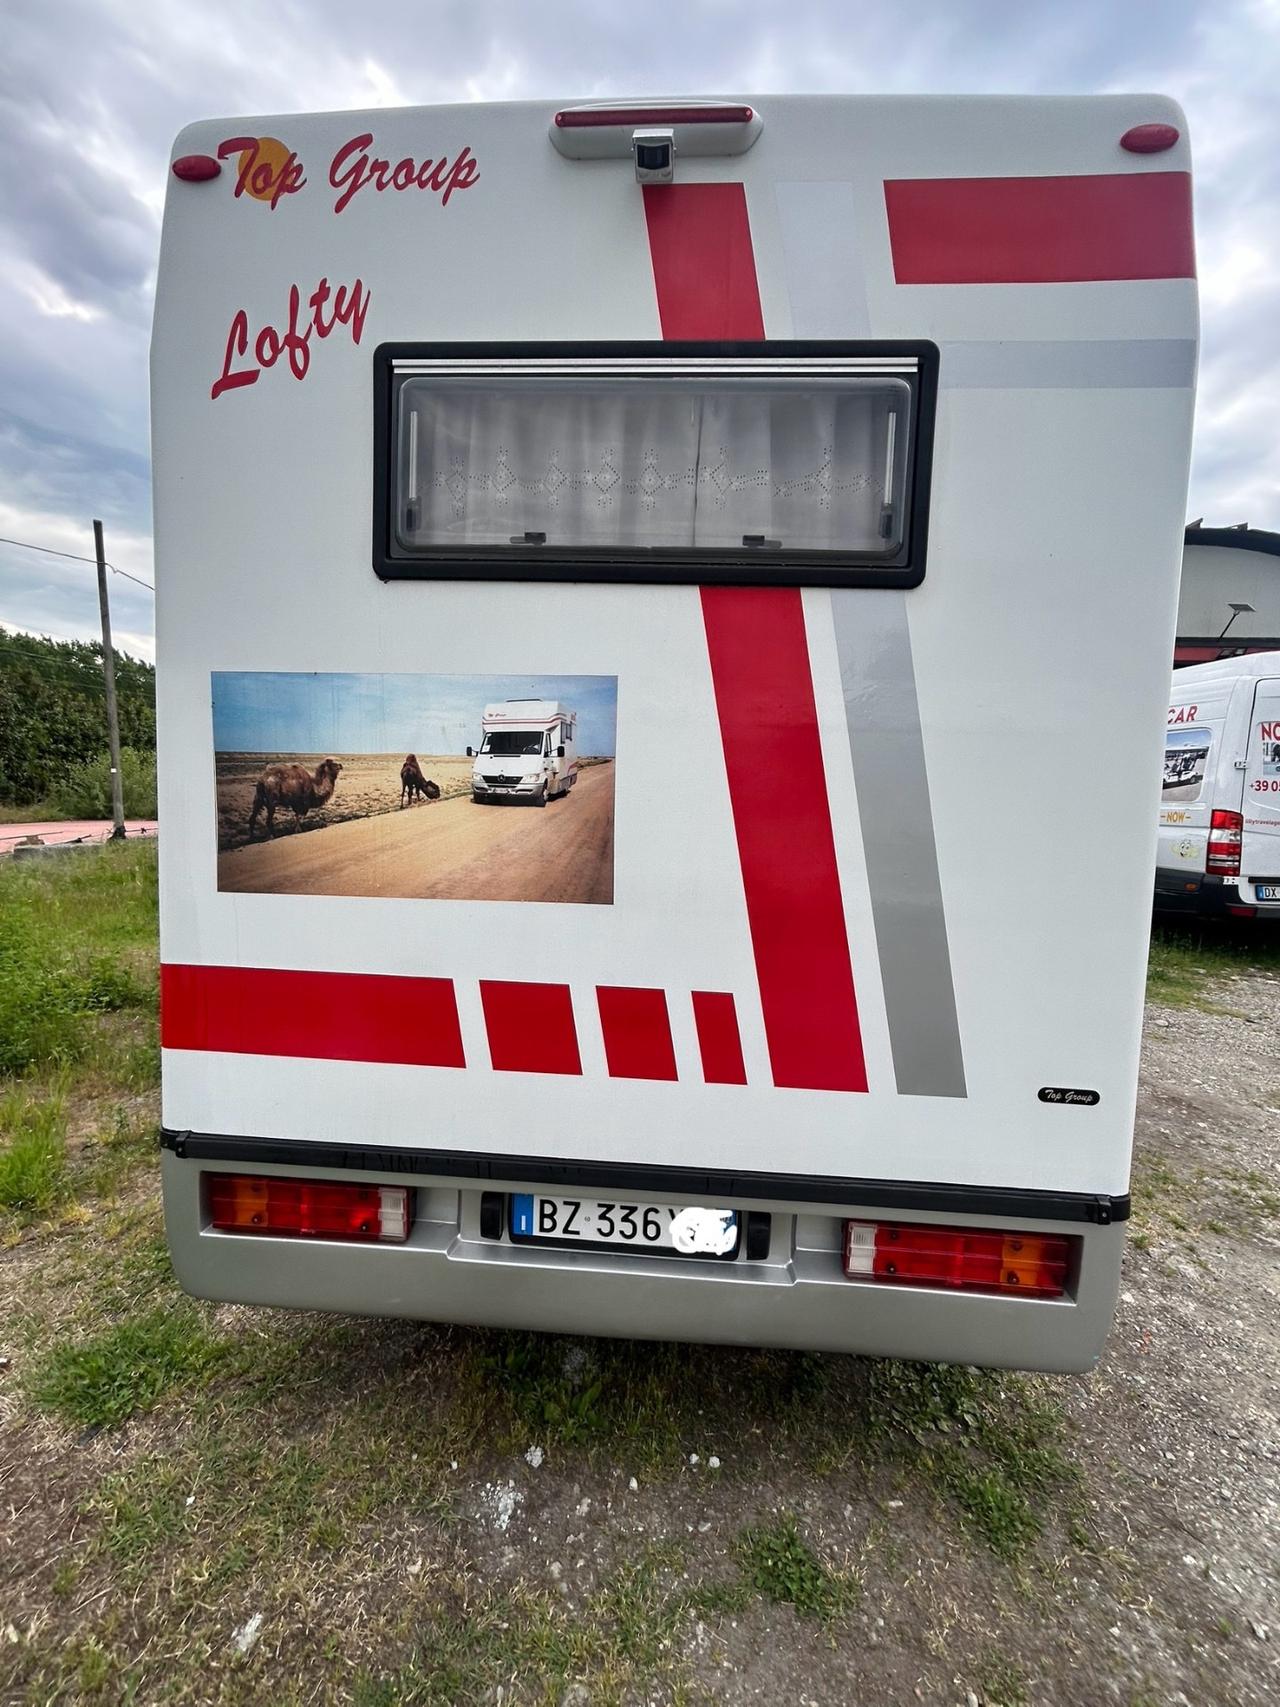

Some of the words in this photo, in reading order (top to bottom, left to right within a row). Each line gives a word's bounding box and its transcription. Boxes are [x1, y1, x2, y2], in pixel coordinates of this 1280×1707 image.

[218, 136, 307, 211] Top
[329, 133, 480, 214] Group
[211, 277, 371, 400] Lofty
[1248, 779, 1269, 792] +39
[1271, 780, 1280, 792] 0
[1264, 887, 1277, 898] DX
[1044, 1089, 1062, 1102] Top
[1064, 1091, 1093, 1104] Group
[538, 1199, 581, 1236] BZ
